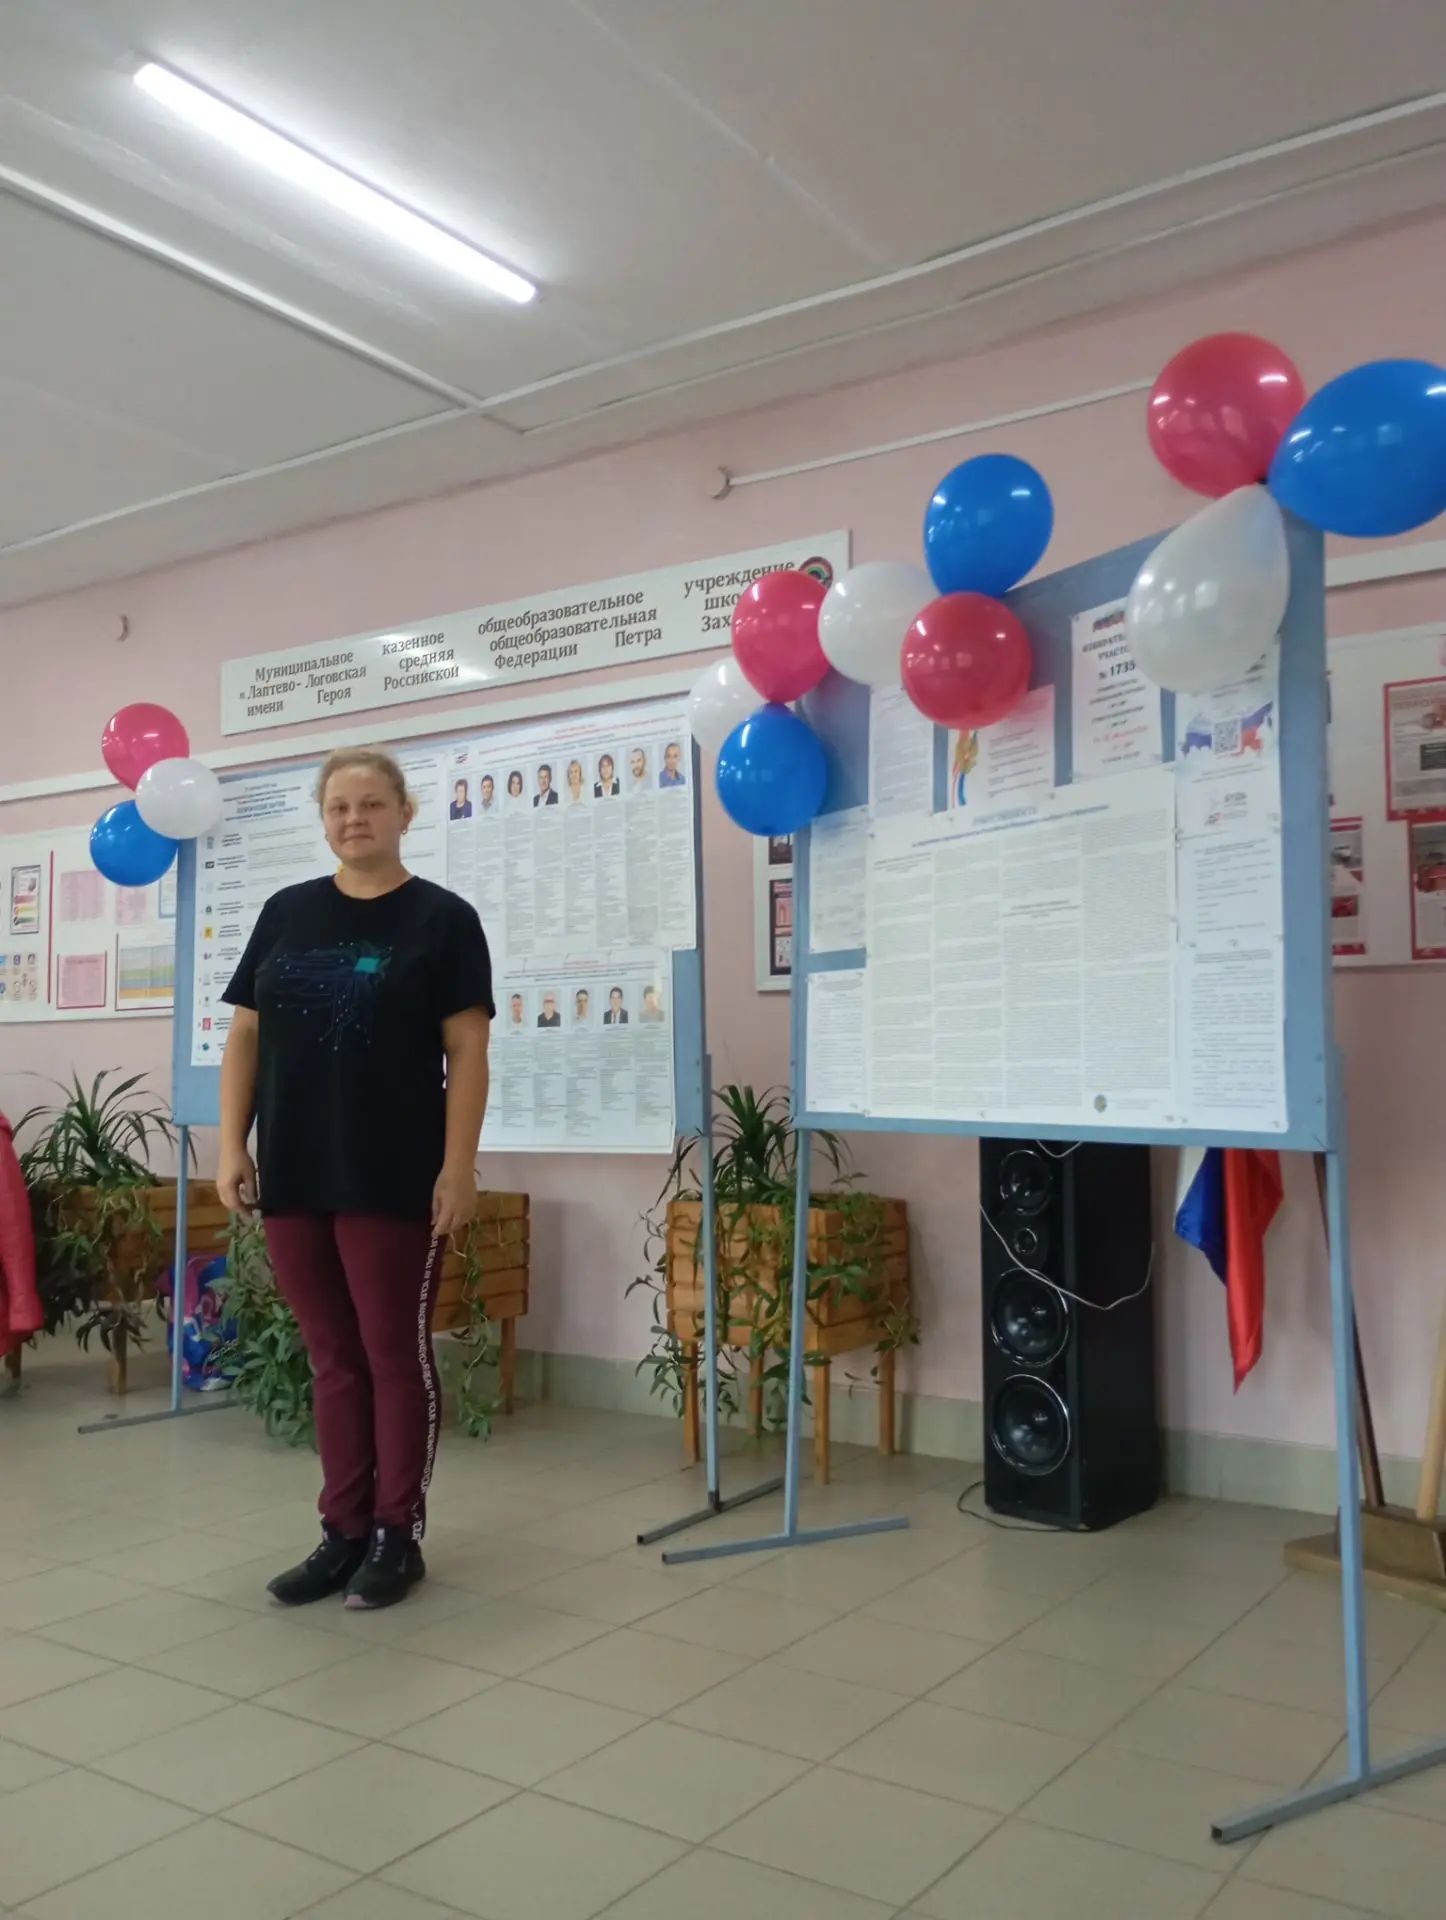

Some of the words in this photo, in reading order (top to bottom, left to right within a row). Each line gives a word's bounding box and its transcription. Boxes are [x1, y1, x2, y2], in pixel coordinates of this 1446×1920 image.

[247, 700, 284, 717] имени
[316, 687, 352, 706] Героя
[384, 665, 459, 691] Российской
[494, 642, 579, 670] Федерации
[614, 627, 663, 649] Петра
[701, 613, 732, 633] Зах
[256, 651, 354, 683] Муниципальное
[382, 632, 445, 656] казенное
[478, 591, 644, 635] общеобразовательное
[399, 648, 454, 673] средняя
[489, 607, 658, 652] общеобразовательная
[704, 592, 740, 611] шко
[1110, 660, 1137, 677] 1735
